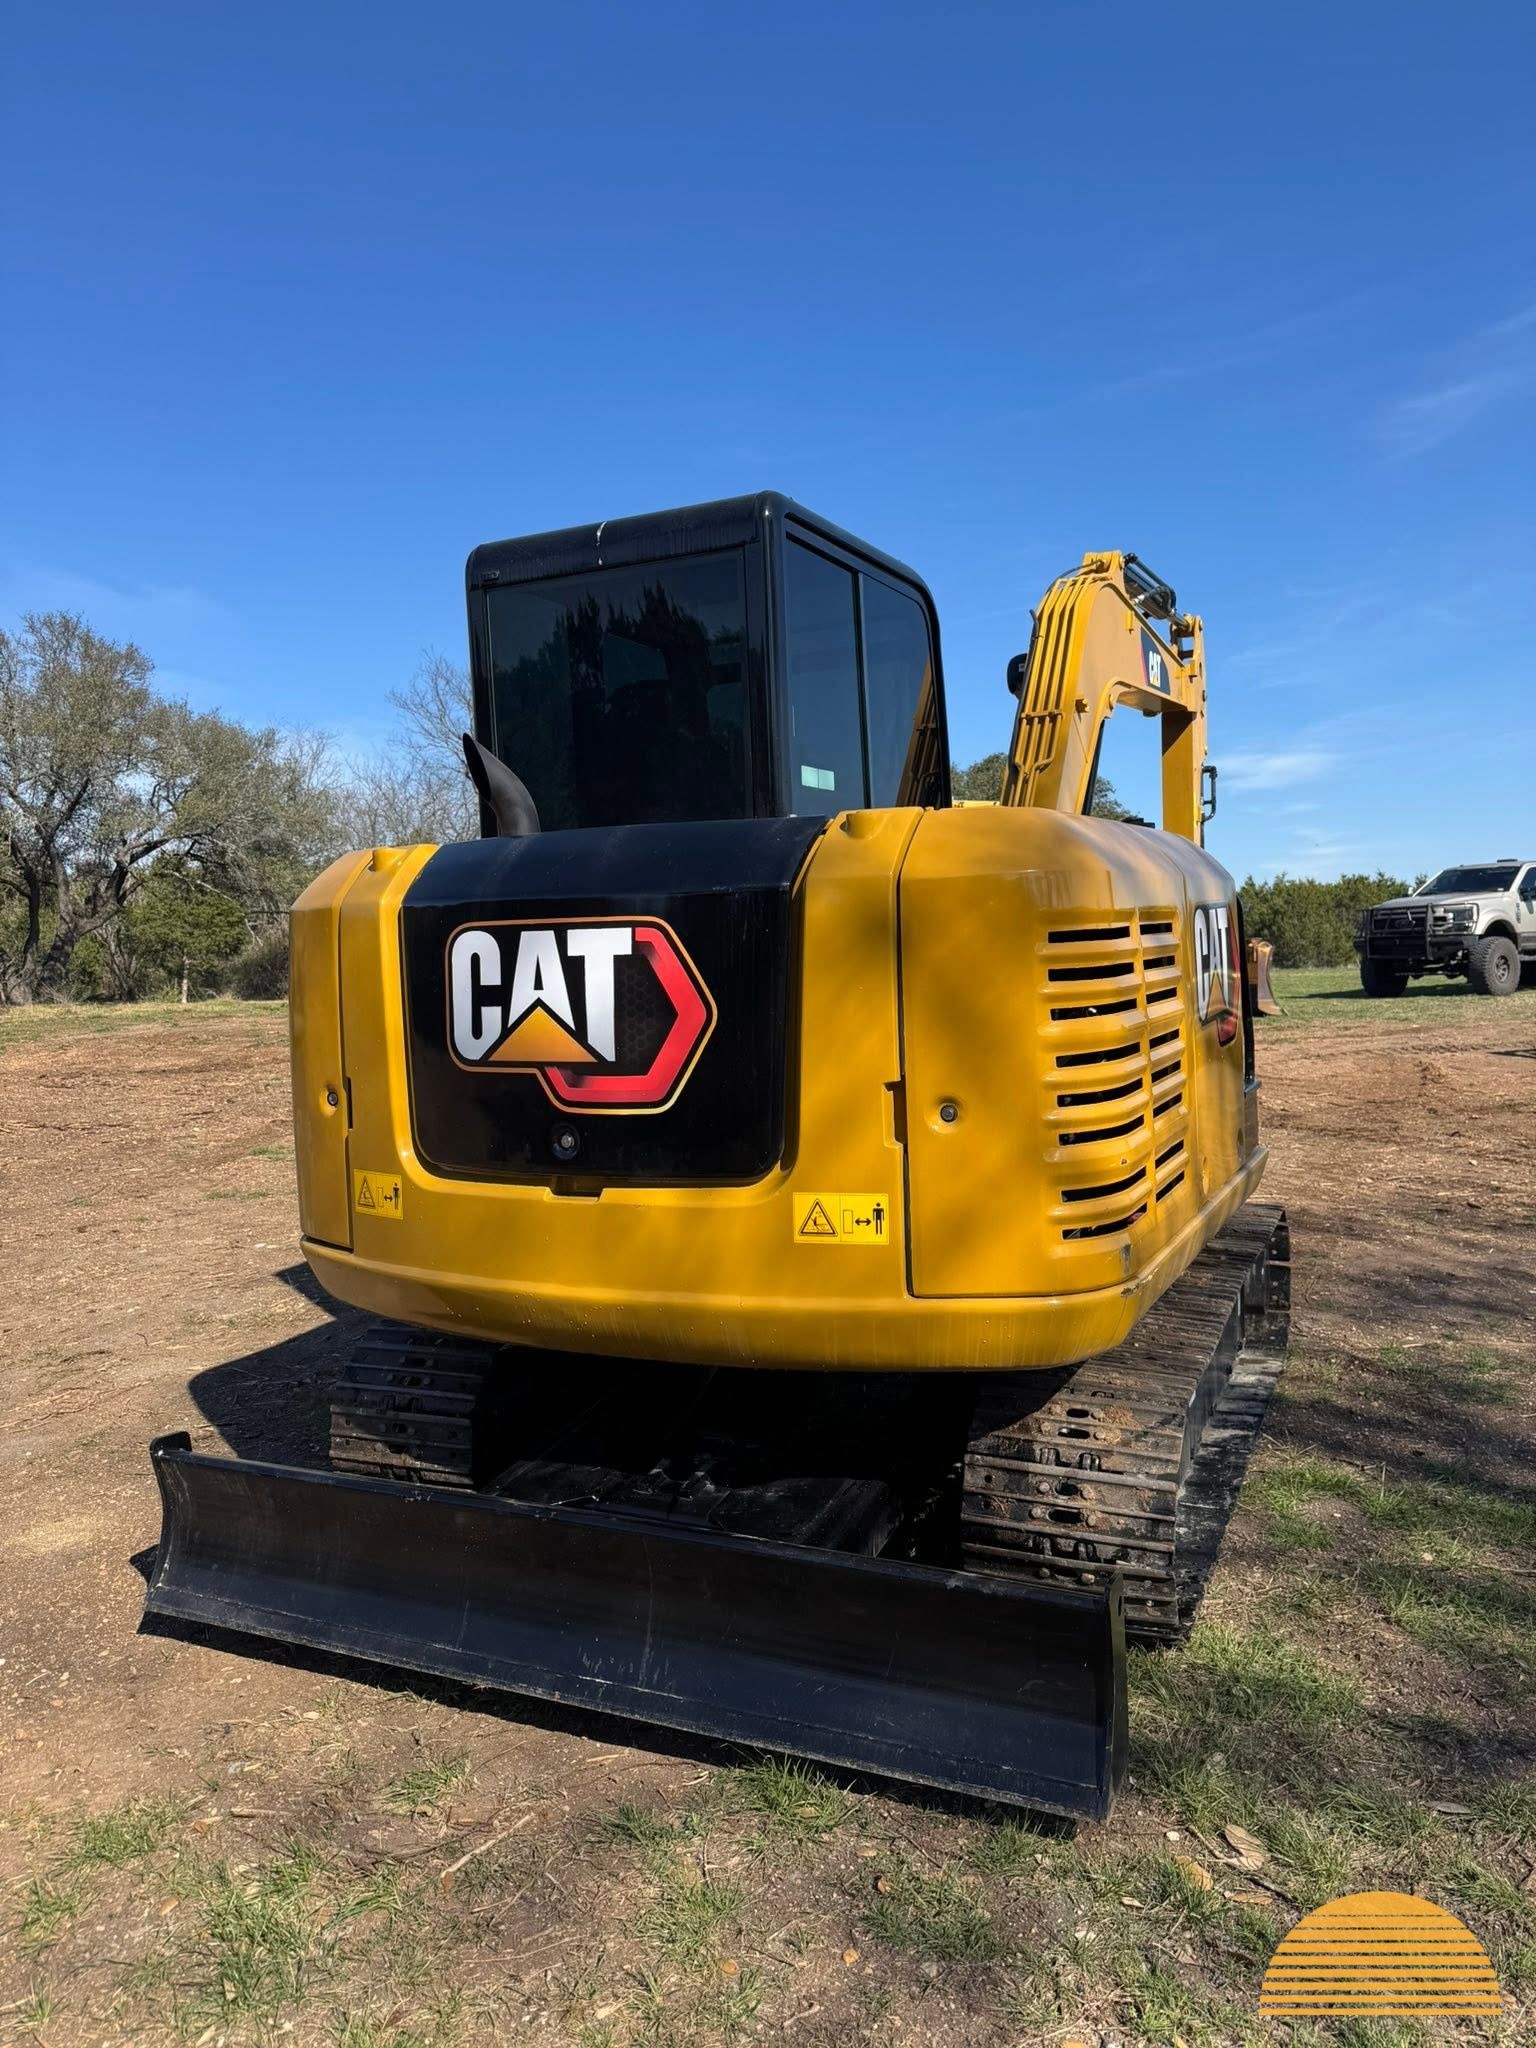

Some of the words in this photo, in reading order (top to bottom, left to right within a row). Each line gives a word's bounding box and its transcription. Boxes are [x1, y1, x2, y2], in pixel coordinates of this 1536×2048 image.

[1148, 650, 1161, 688] CAT
[451, 927, 632, 1062] CAT
[1194, 907, 1228, 1021] CAT
